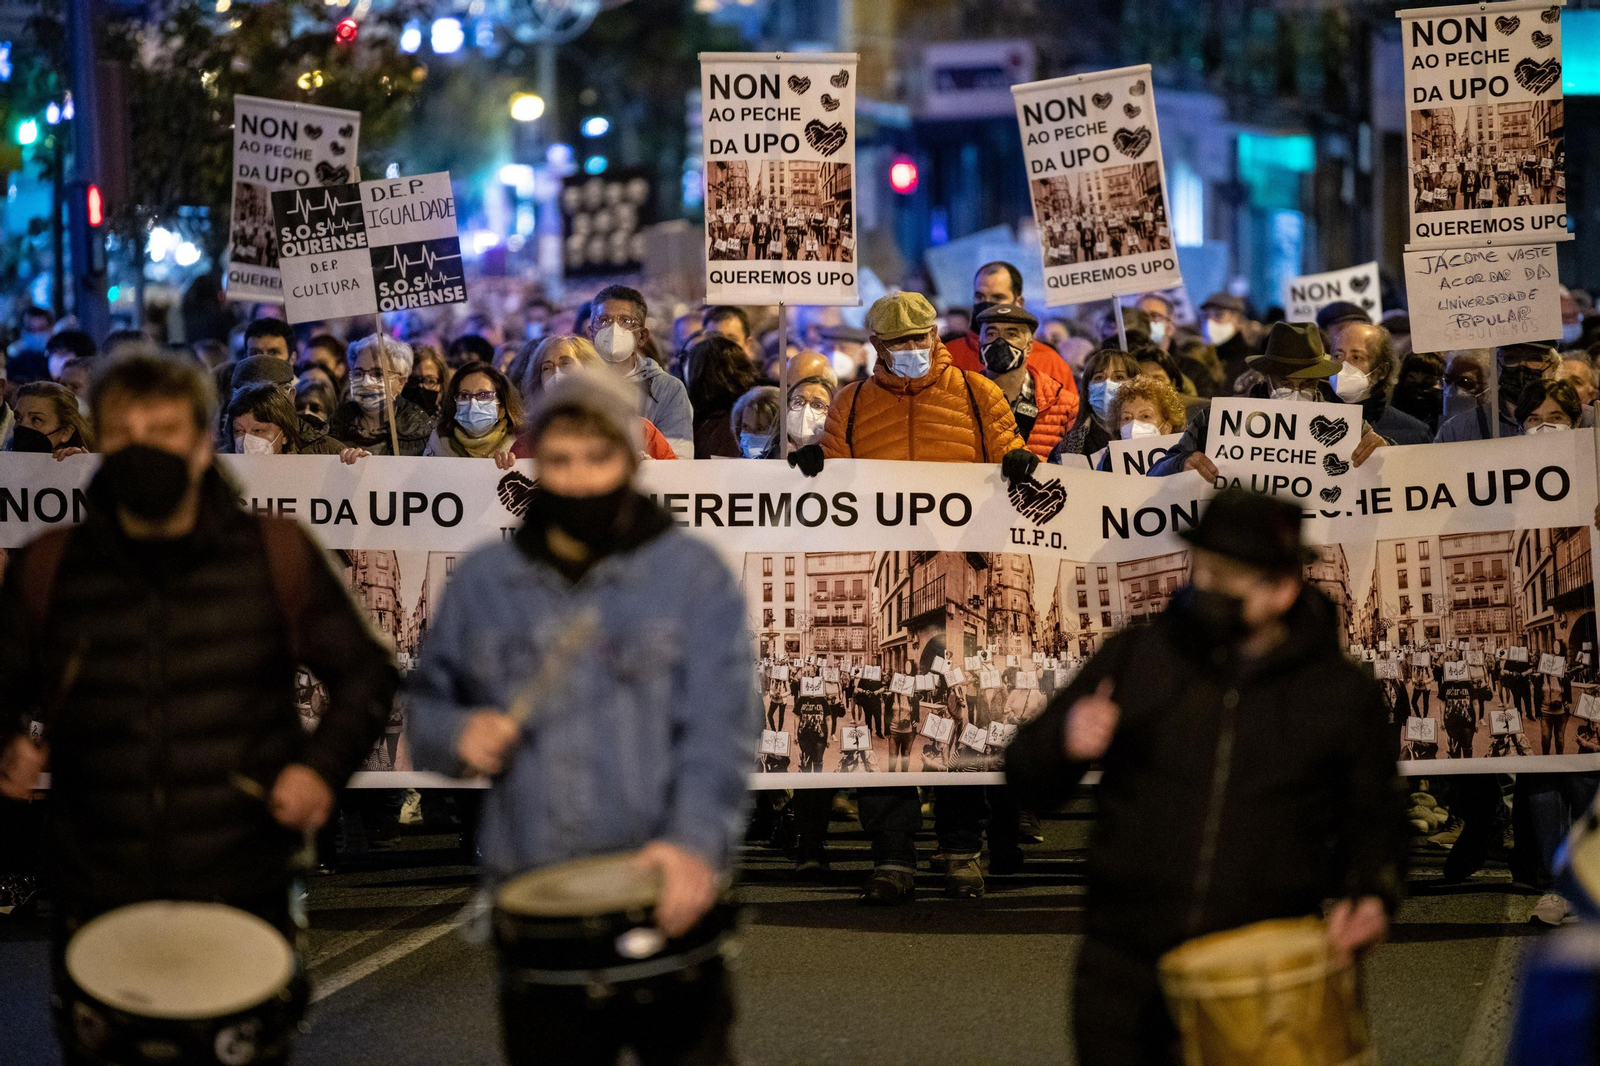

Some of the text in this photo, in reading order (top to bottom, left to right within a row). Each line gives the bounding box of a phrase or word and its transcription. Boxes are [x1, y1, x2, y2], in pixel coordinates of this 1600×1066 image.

[1412, 16, 1488, 47] NON
[1411, 49, 1510, 70] AO PECHE
[710, 74, 780, 100] NON
[1413, 76, 1509, 104] DA UPO
[709, 107, 801, 122] AO PECHE
[1023, 95, 1087, 126] NON
[241, 114, 298, 142] NON
[1027, 121, 1108, 146] AO PECHE
[239, 140, 313, 161] AO PECHE
[710, 133, 800, 154] DA UPO
[1031, 145, 1110, 174] DA UPO
[238, 164, 310, 186] DA UPO
[367, 197, 456, 229] IGUALDADE
[281, 222, 327, 242] S.O.S
[1416, 217, 1524, 238] QUEREMOS
[281, 232, 367, 257] OURENSE
[1507, 247, 1552, 262] VASTE
[229, 270, 283, 289] QUERE
[710, 270, 854, 286] QUEREMOS UPO
[1047, 258, 1175, 288] QUEREMOS UPO
[1524, 264, 1551, 281] DA
[292, 278, 360, 298] CULTURA
[378, 276, 425, 297] S.O.S
[1291, 280, 1341, 301] NON
[379, 286, 465, 312] OURENSE
[1446, 306, 1532, 328] POPULAR
[1220, 410, 1297, 441] NON
[1215, 445, 1317, 465] AO PECHE
[1213, 474, 1312, 498] DA UPO
[310, 498, 358, 525] DA
[369, 491, 464, 528] UPO
[651, 491, 859, 528] EREMOS
[875, 492, 972, 527] UPO
[1102, 500, 1199, 539] NON
[1405, 483, 1457, 512] DA
[1466, 466, 1571, 507] UPO
[1010, 527, 1067, 550] U.P.O.
